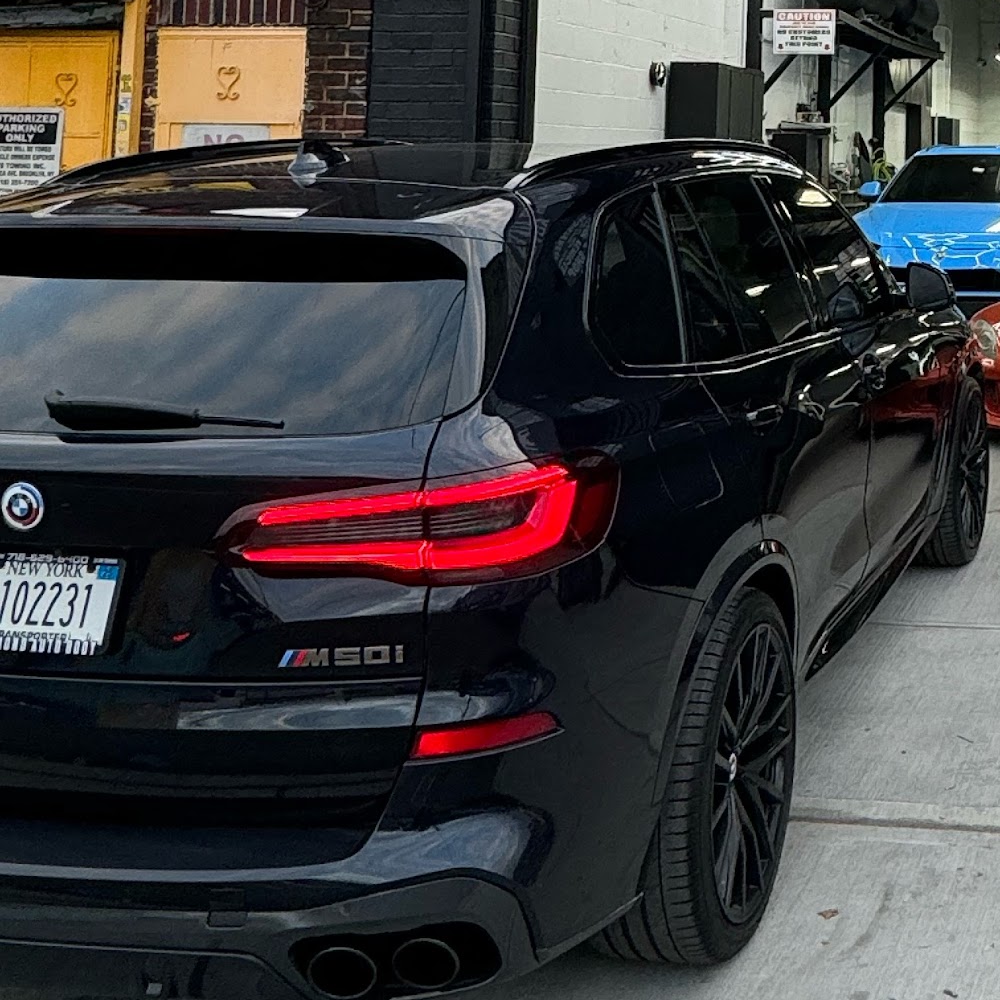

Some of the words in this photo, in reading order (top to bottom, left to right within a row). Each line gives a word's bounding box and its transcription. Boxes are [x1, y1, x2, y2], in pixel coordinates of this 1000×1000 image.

[778, 12, 830, 20] CAUTION
[0, 113, 57, 124] THORIZED
[5, 133, 35, 143] ONLY
[7, 561, 41, 576] NEW
[45, 562, 83, 578] YORK
[0, 580, 93, 629] 102231
